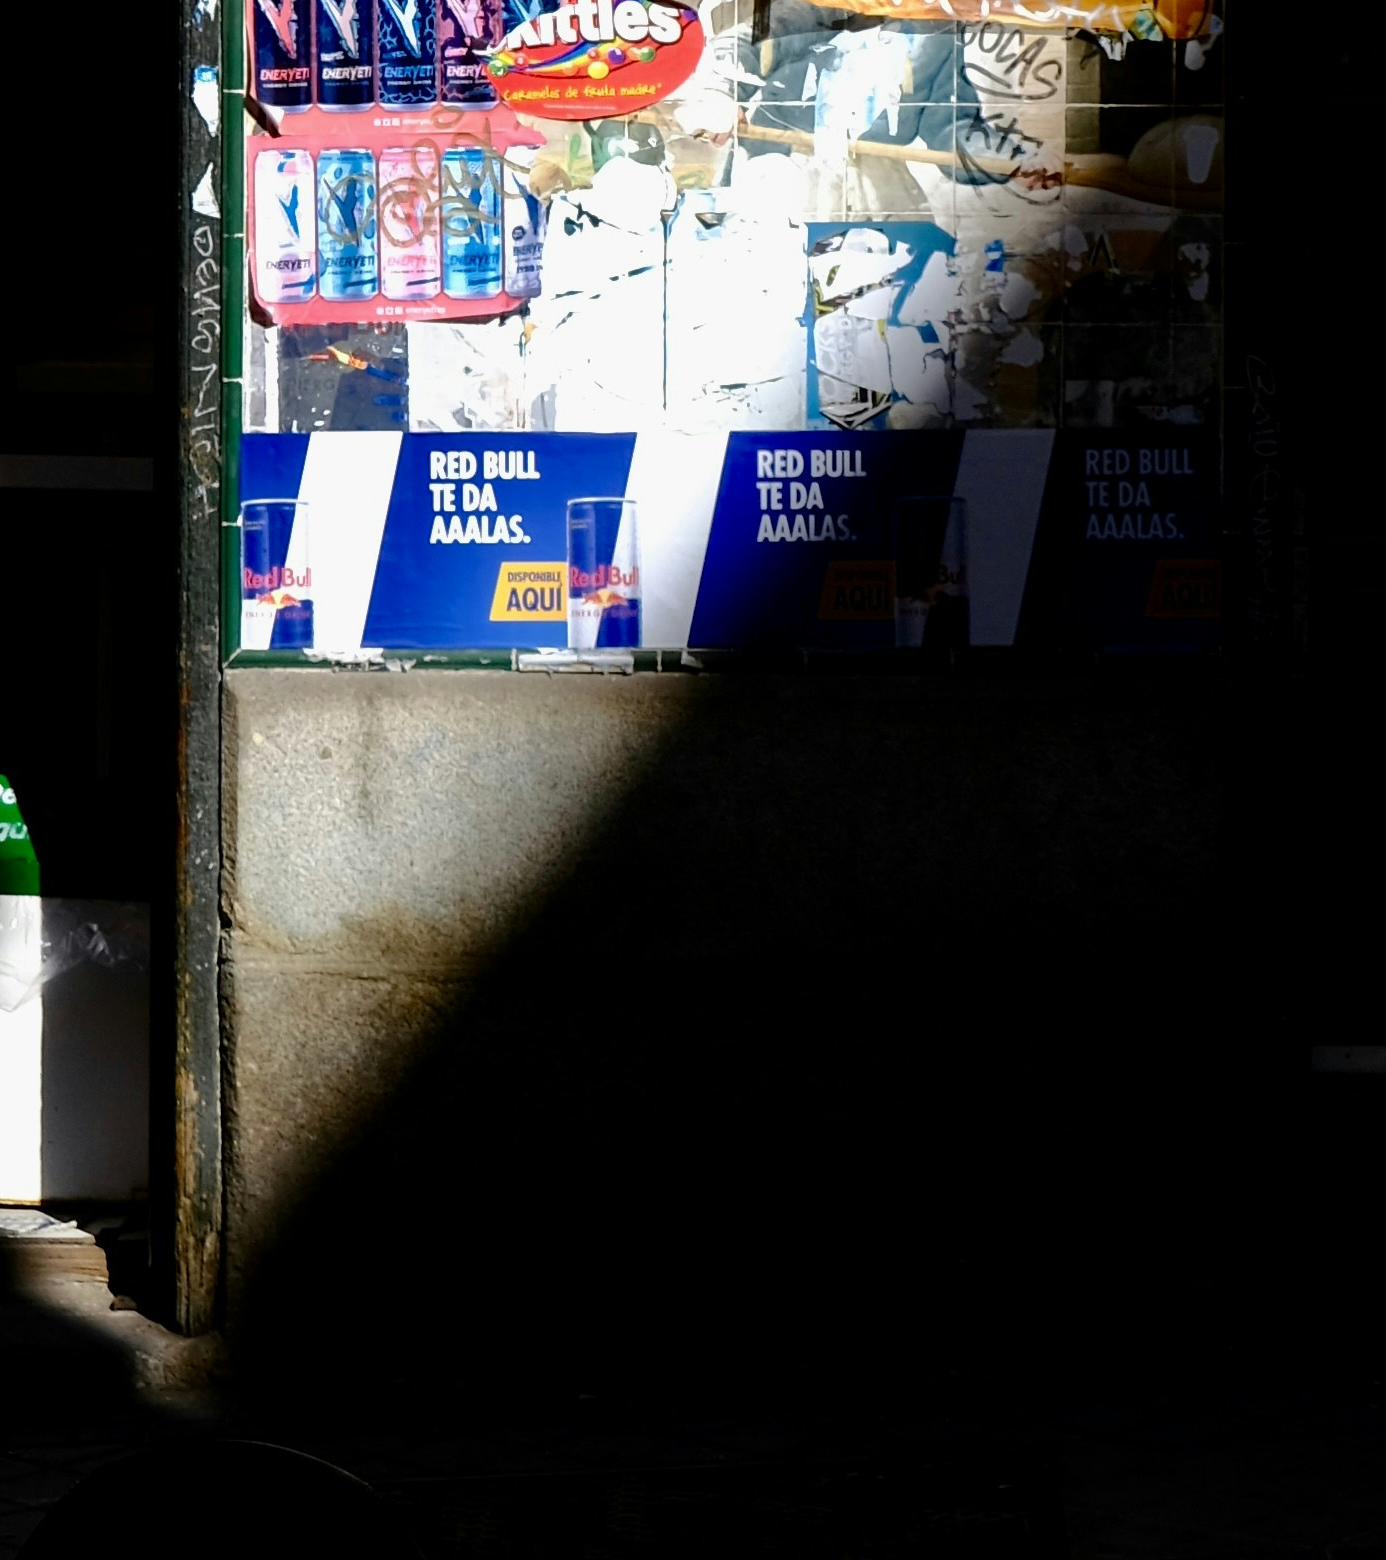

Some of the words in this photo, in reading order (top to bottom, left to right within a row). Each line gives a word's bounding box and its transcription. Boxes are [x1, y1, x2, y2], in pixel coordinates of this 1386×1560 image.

[430, 451, 476, 480] RED
[483, 451, 540, 480] BULL
[757, 450, 804, 478] RED
[810, 450, 867, 478] BULL
[1085, 449, 1132, 476] RED
[1138, 449, 1195, 476] BULL
[430, 484, 457, 512] TE
[463, 484, 497, 512] DA
[756, 481, 783, 510] TE
[790, 481, 824, 510] DA
[1085, 481, 1112, 508] TE
[1117, 481, 1152, 508] DA
[430, 516, 531, 544] AAALAS.
[757, 514, 858, 543] AAALAS.
[1085, 513, 1185, 541] AAALAS.
